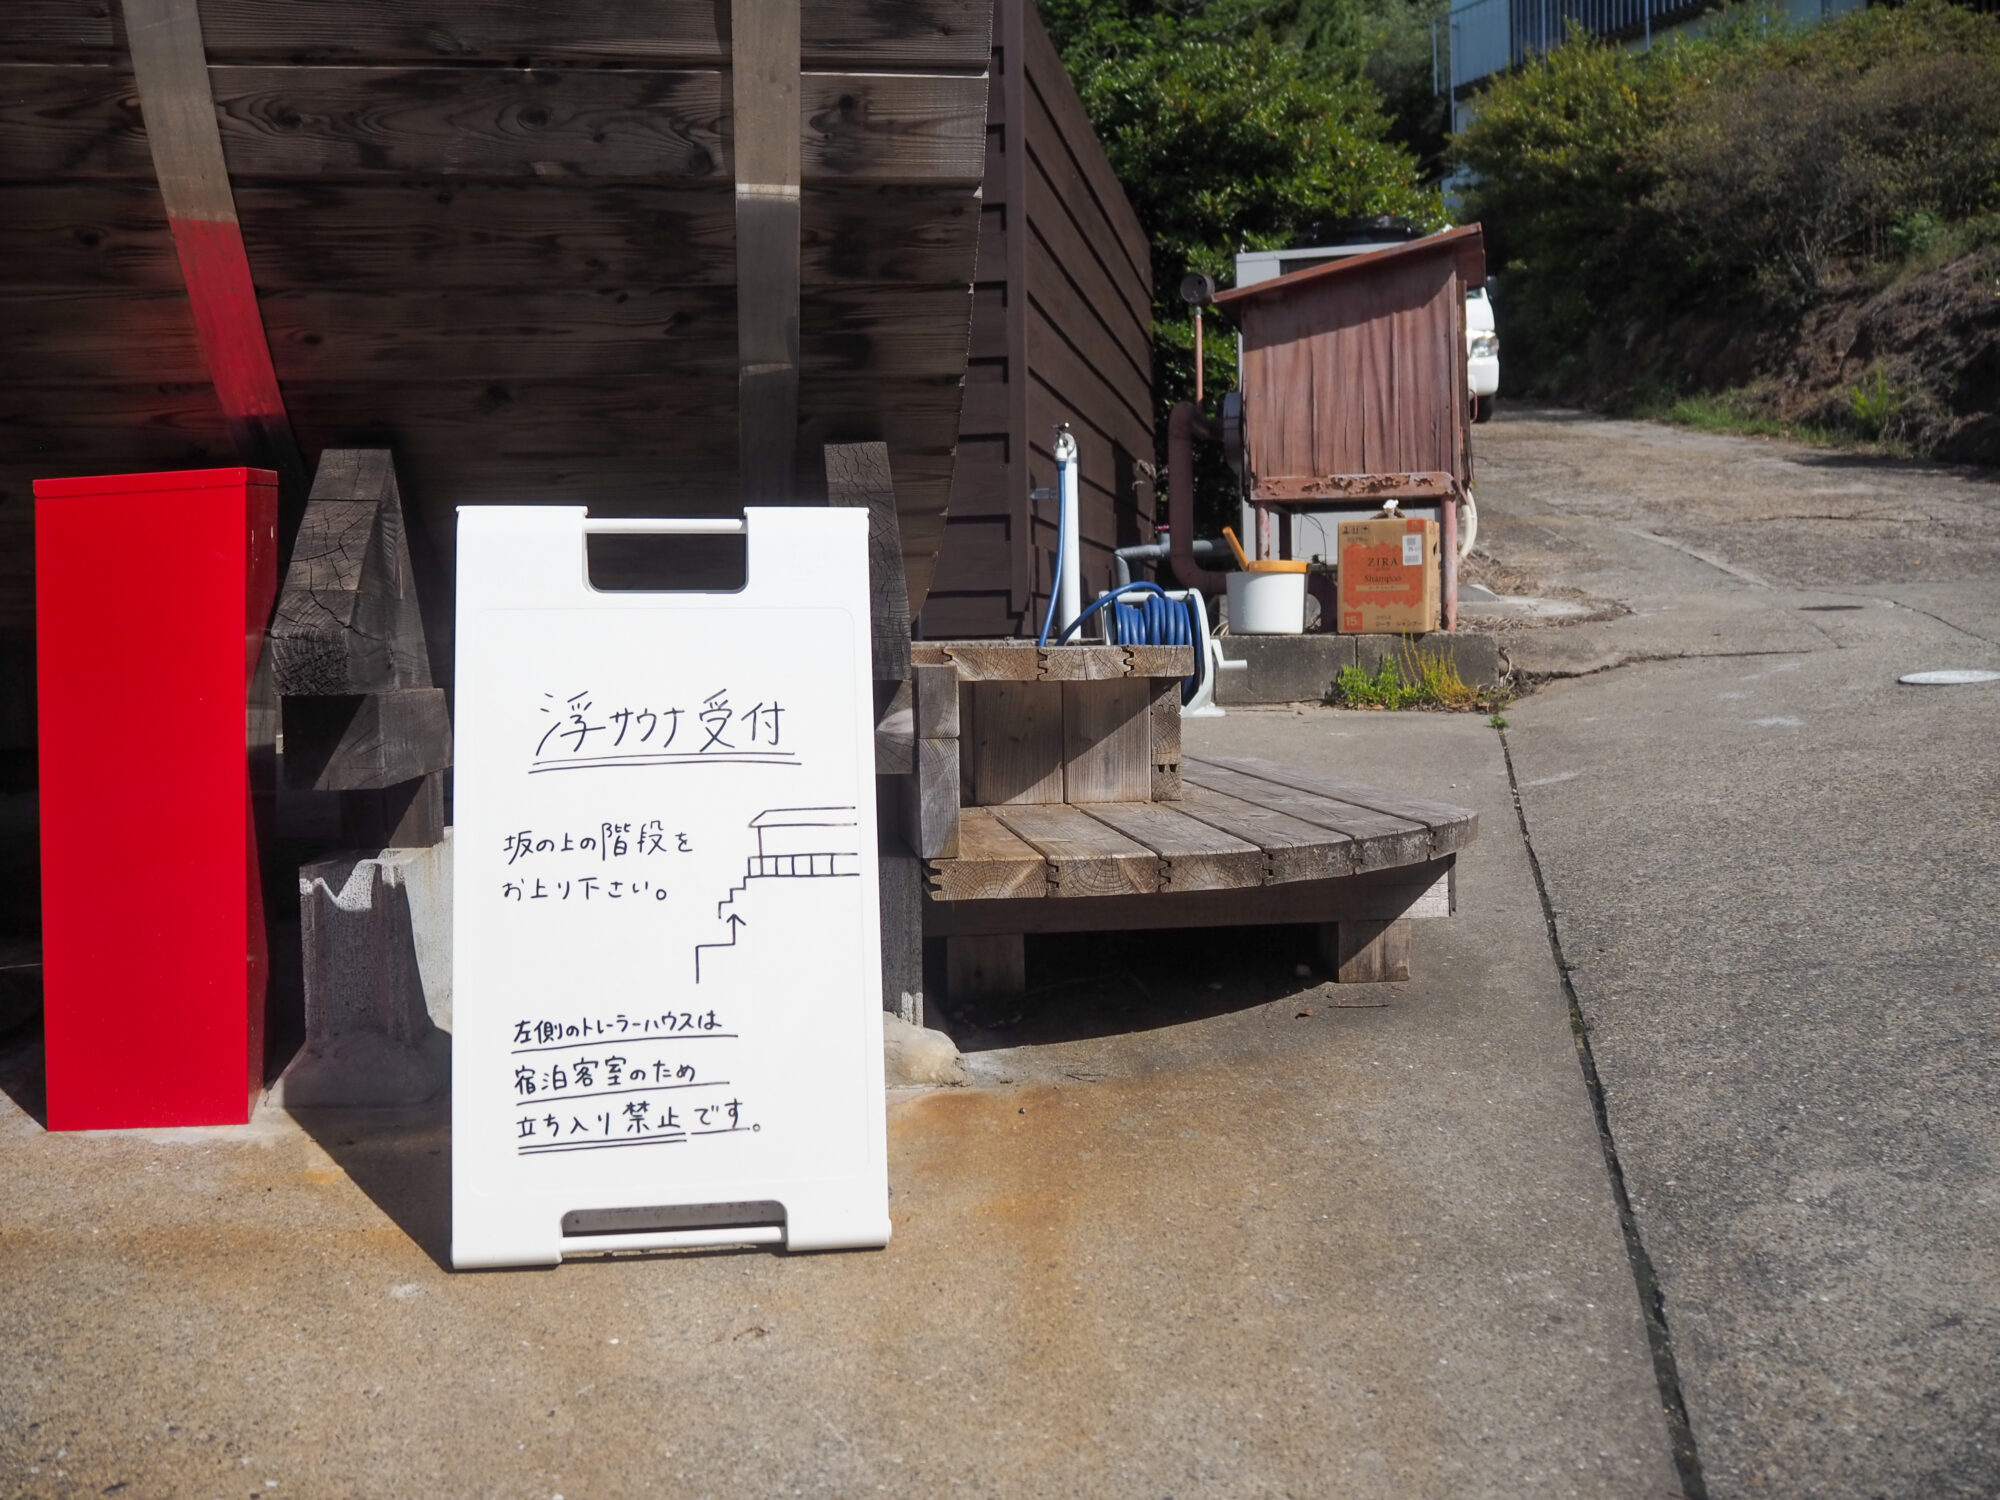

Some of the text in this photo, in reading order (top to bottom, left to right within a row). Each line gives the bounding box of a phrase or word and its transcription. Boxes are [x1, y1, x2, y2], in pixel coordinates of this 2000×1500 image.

[1364, 574, 1402, 584] Shampoo
[1367, 557, 1398, 567] ZIRA
[535, 688, 785, 757] 浮サウナ受付
[503, 820, 693, 863] 坂の上の階段を
[502, 877, 668, 902] お上り下さい。
[513, 1009, 723, 1045] 左側のトレーラーハウスは
[514, 1055, 697, 1095] 宿泊客室のため
[516, 1098, 762, 1138] 立ち入り禁止です。
